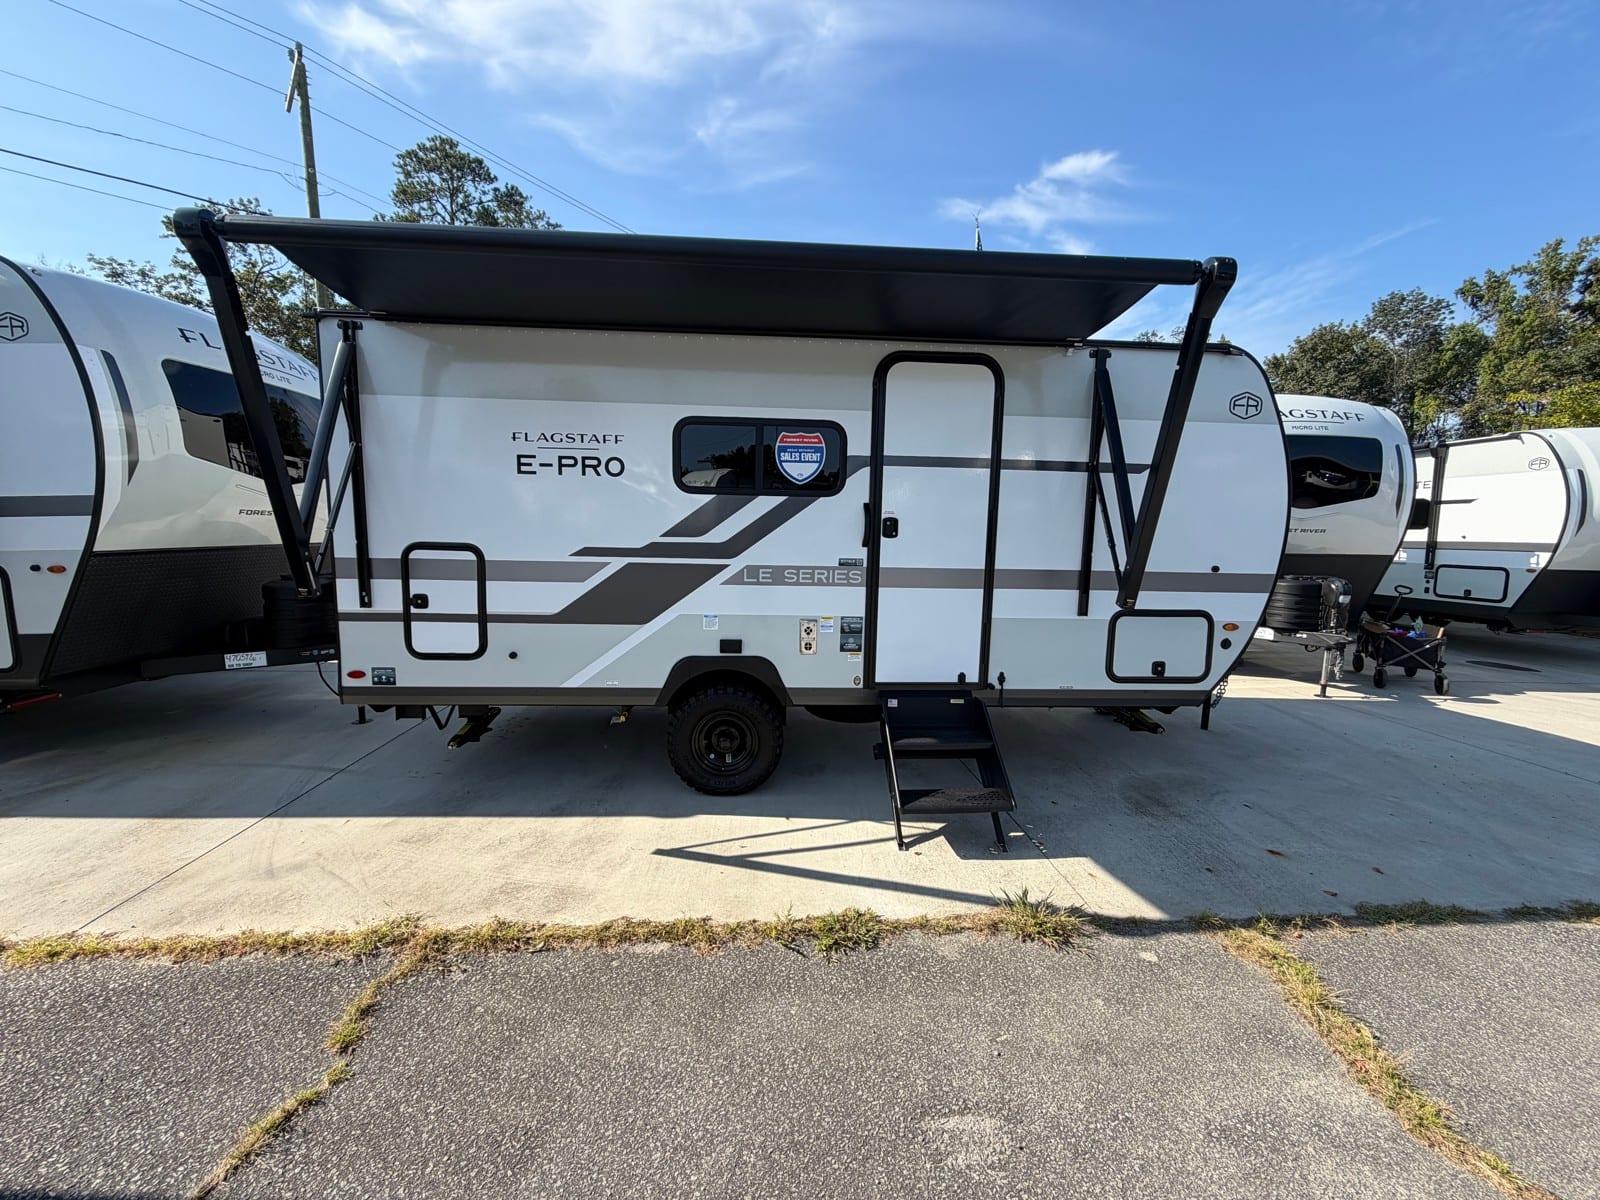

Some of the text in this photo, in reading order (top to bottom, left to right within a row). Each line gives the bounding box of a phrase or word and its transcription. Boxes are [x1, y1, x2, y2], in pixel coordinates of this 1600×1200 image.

[1279, 408, 1365, 422] AGSTAFF
[511, 431, 625, 445] FLAGSTAFF
[780, 452, 821, 462] SALES EVENT
[516, 454, 626, 478] E-PRO
[238, 508, 273, 516] FORES
[743, 568, 862, 584] LE SERIES
